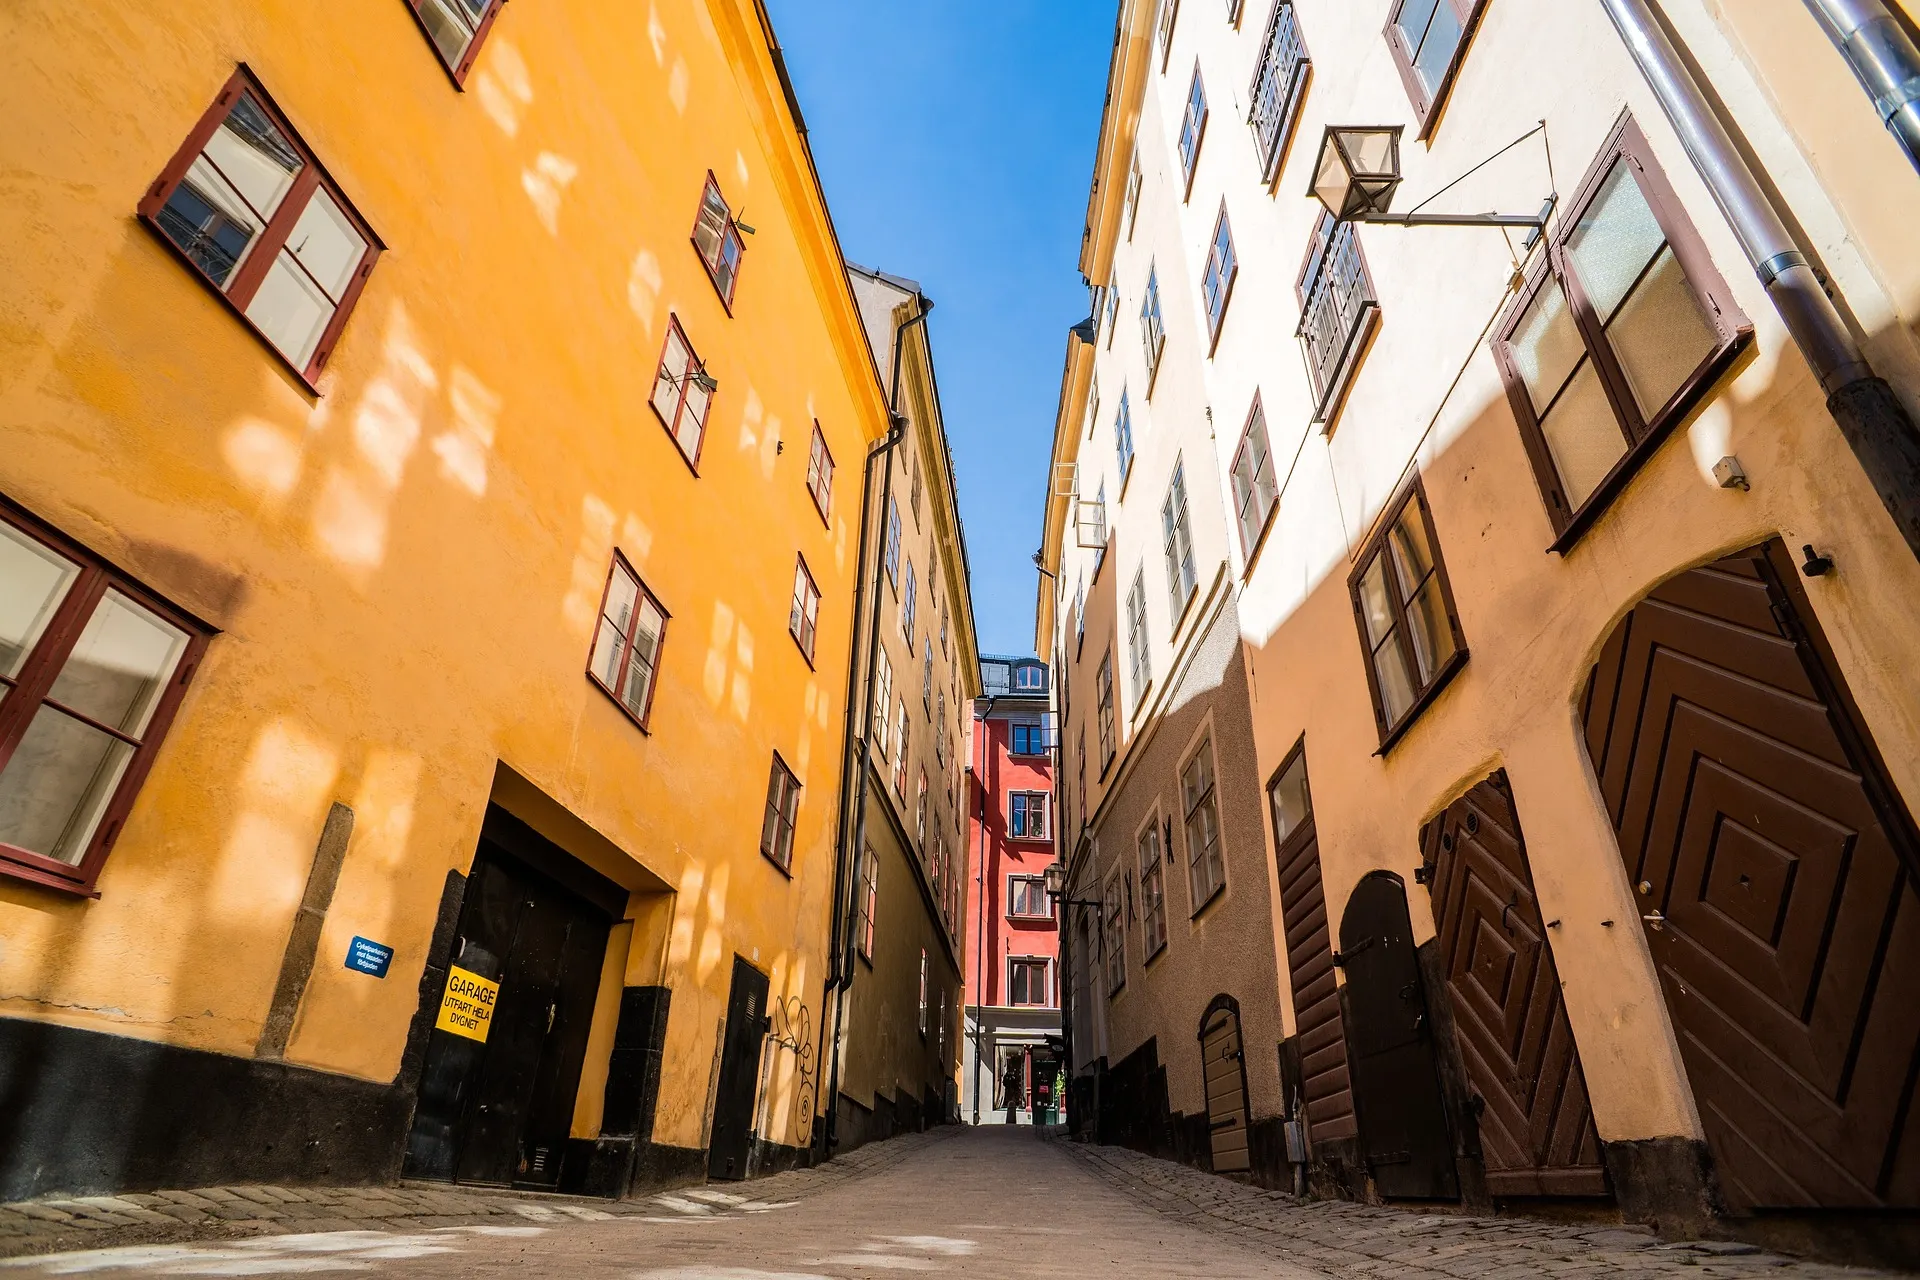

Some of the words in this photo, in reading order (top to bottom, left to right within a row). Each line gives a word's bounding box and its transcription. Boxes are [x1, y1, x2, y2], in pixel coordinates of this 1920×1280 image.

[449, 975, 496, 1005] GARAGE
[444, 995, 473, 1014] UTFART
[472, 1005, 490, 1021] HELA
[449, 1012, 479, 1030] DYGNET
